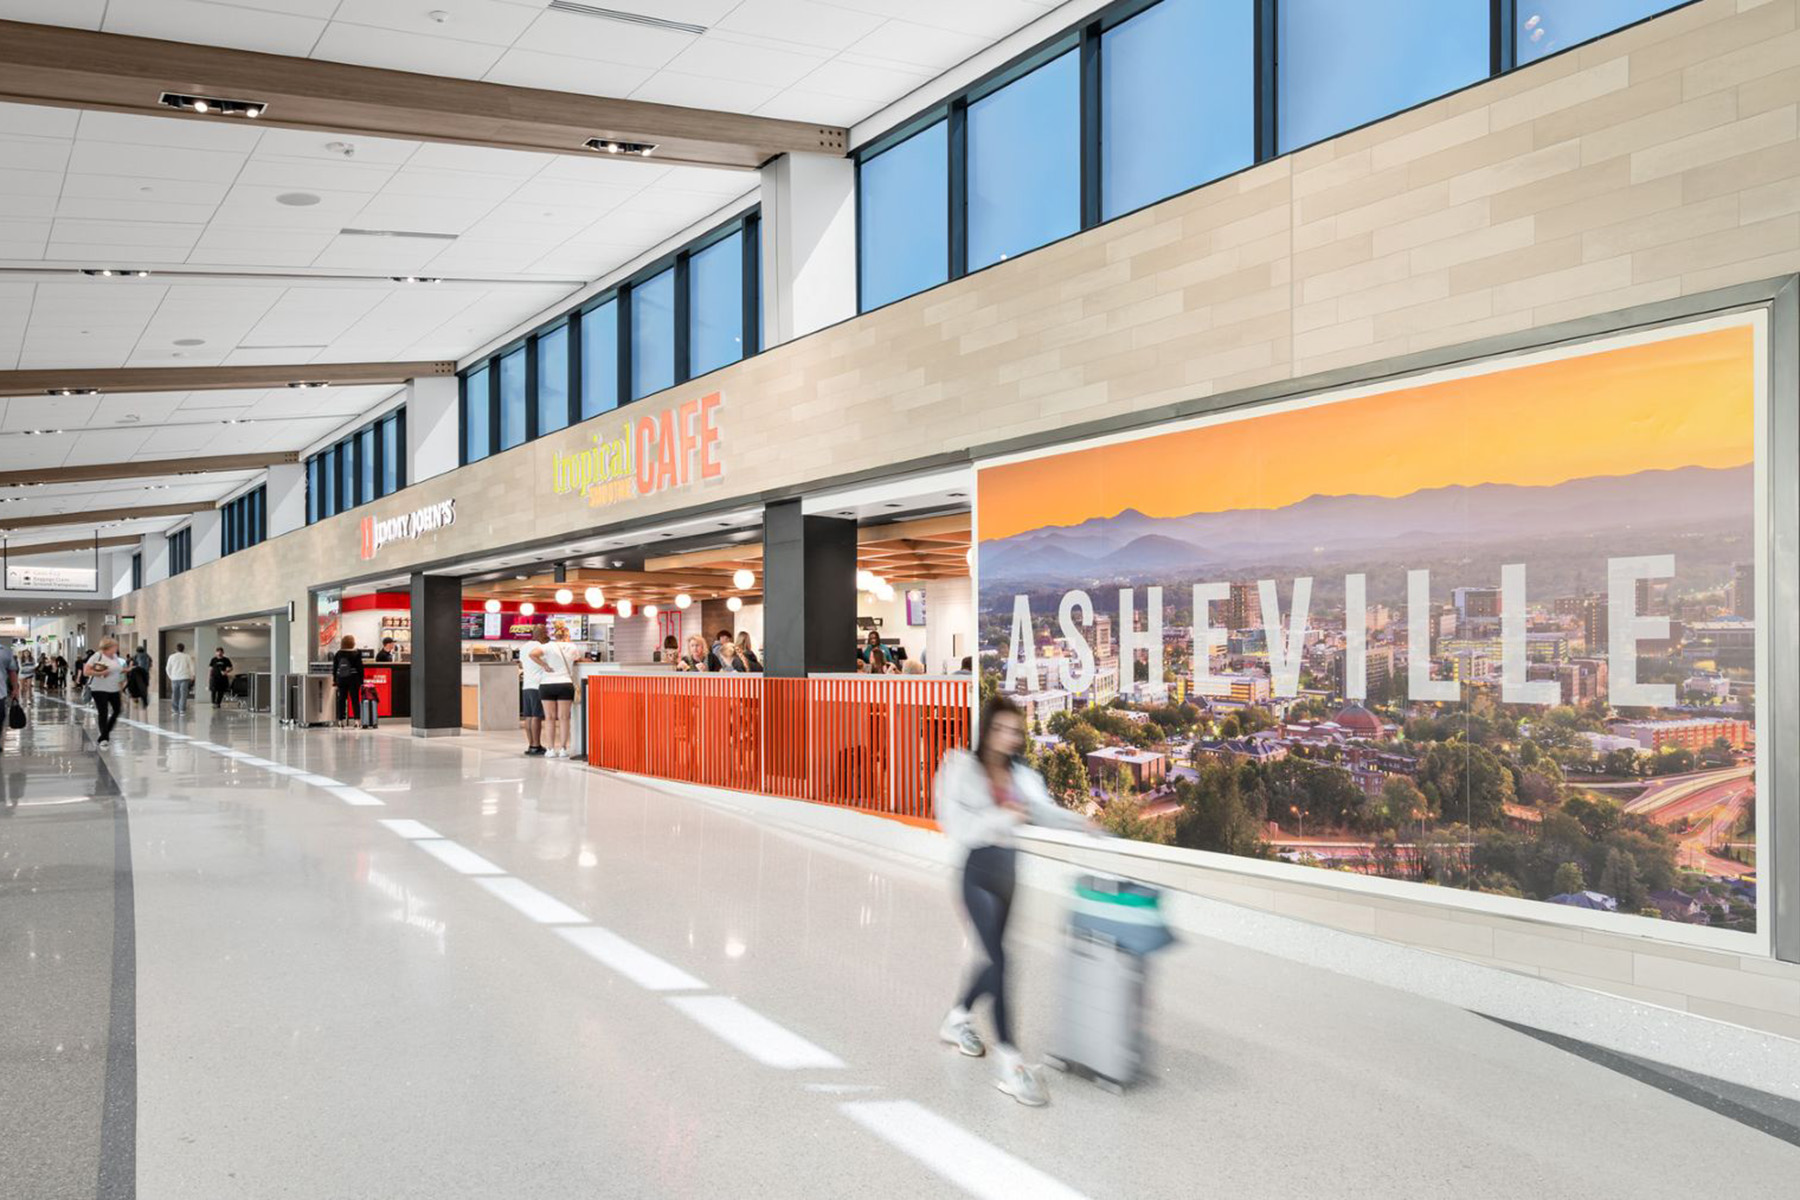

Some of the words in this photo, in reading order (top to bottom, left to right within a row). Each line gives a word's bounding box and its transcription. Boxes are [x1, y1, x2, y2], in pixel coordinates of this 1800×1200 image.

[552, 421, 632, 496] tropical
[635, 392, 723, 494] CAFE
[376, 513, 411, 549] JIMMY
[411, 498, 456, 539] JOHN'S
[1005, 554, 1675, 706] ASHEVILLE
